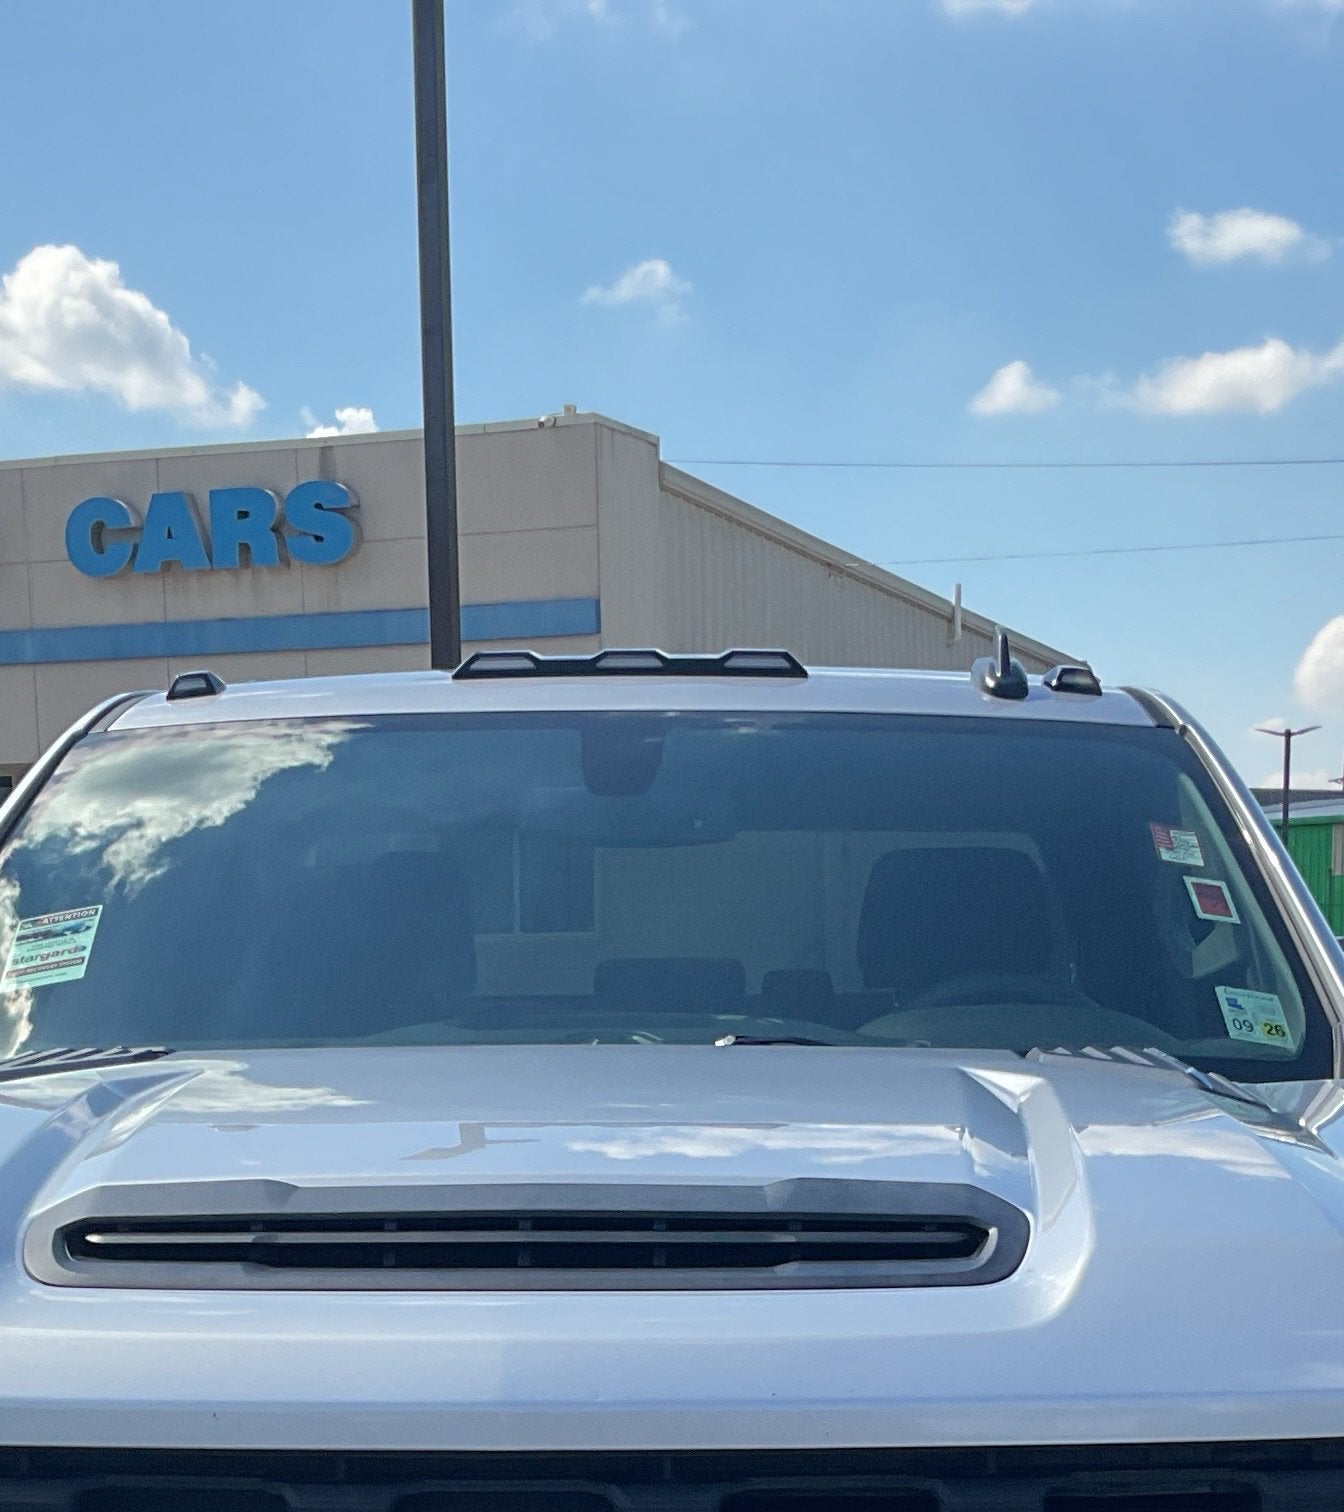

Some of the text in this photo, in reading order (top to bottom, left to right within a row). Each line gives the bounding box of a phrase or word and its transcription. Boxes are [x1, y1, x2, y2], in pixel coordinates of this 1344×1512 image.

[65, 480, 355, 578] CARS
[42, 909, 97, 924] ATTENTION
[1232, 1017, 1286, 1037] 09 26
